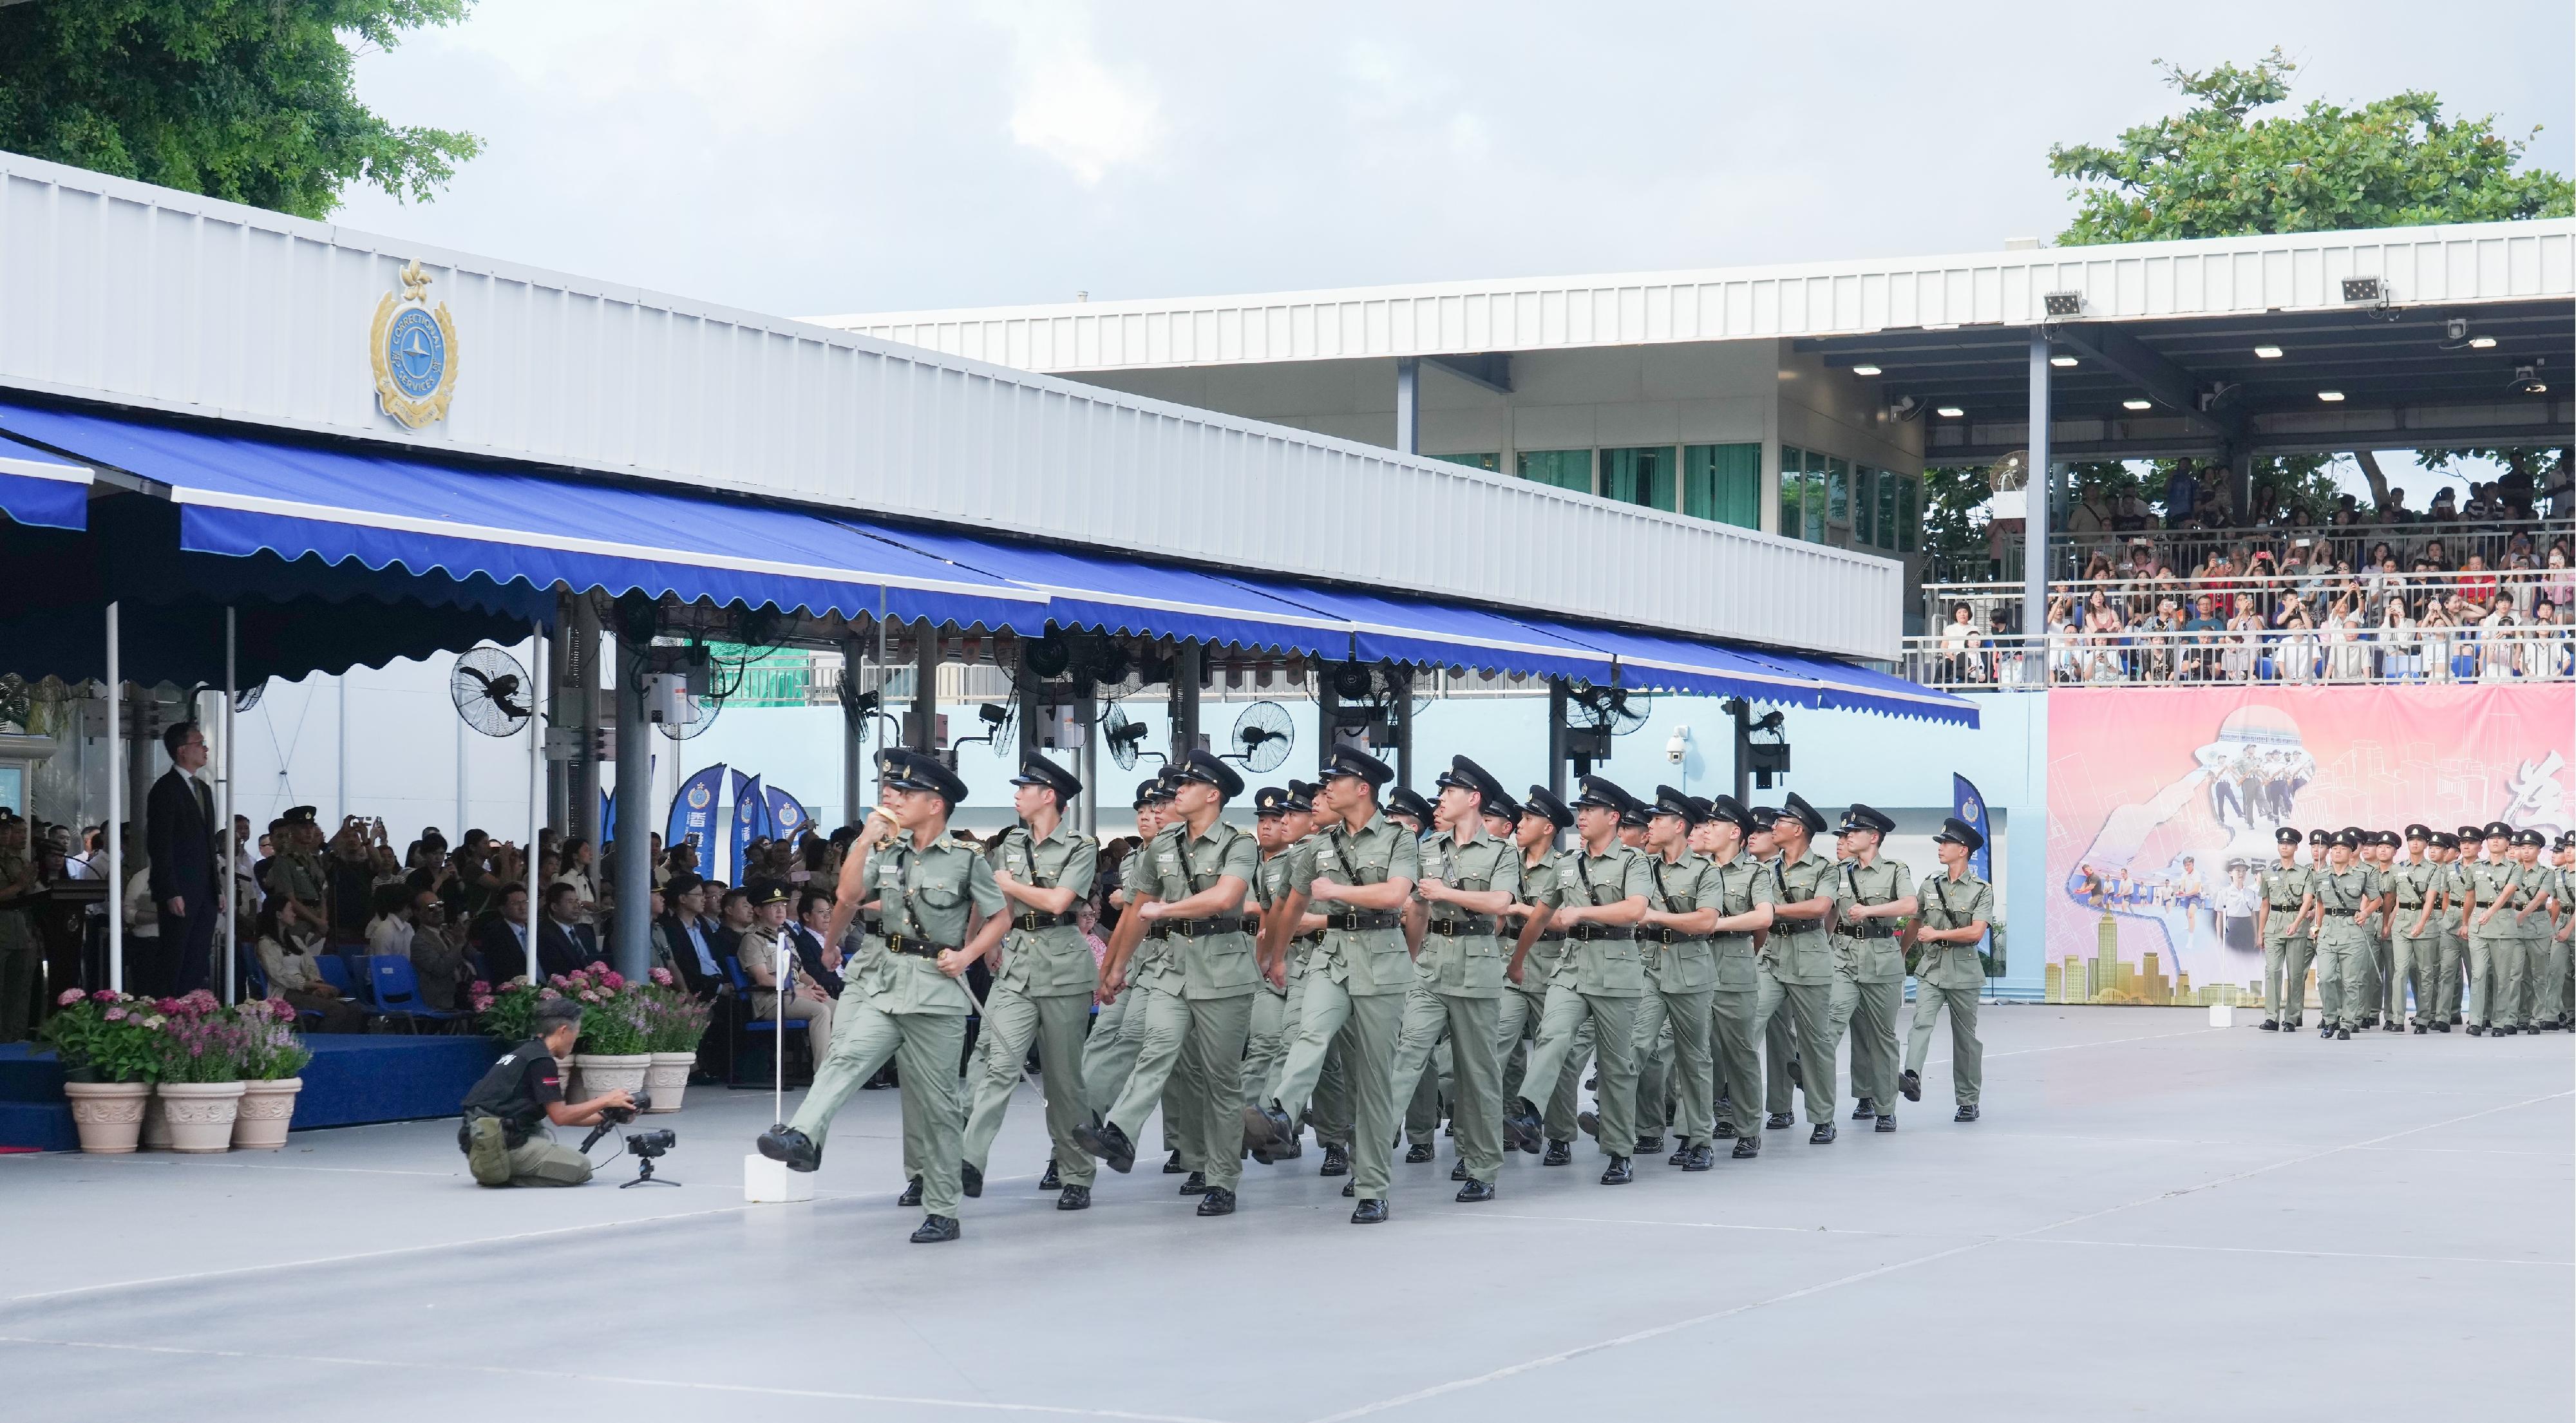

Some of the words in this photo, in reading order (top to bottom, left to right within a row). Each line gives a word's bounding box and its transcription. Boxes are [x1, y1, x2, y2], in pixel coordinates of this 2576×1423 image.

[393, 314, 442, 352] CORRECTIONAL
[398, 370, 434, 391] SERVICES
[395, 401, 413, 422] HONG
[419, 406, 437, 423] KONG
